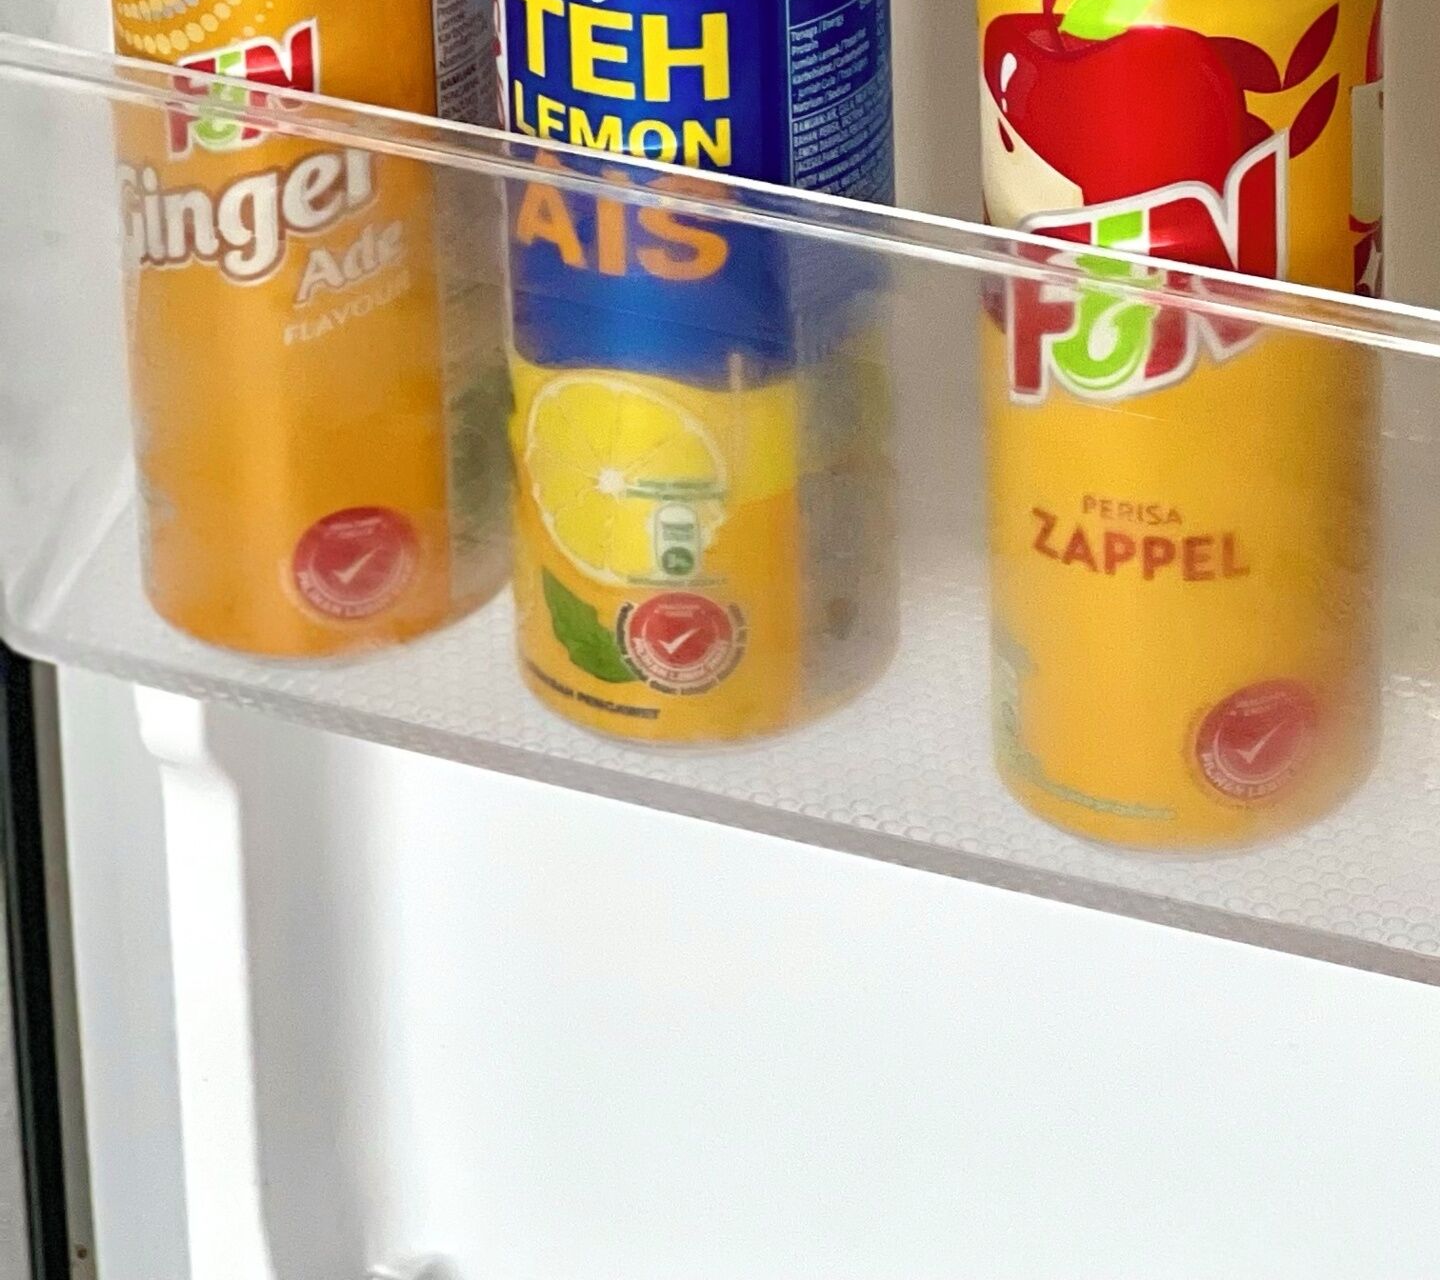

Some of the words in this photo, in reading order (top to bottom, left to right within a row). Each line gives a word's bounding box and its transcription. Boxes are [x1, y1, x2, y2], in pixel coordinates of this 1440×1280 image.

[514, 80, 732, 168] LEMON
[516, 148, 728, 281] AIS
[1032, 507, 1250, 582] ZAPPEL
[1082, 495, 1183, 526] PERISA
